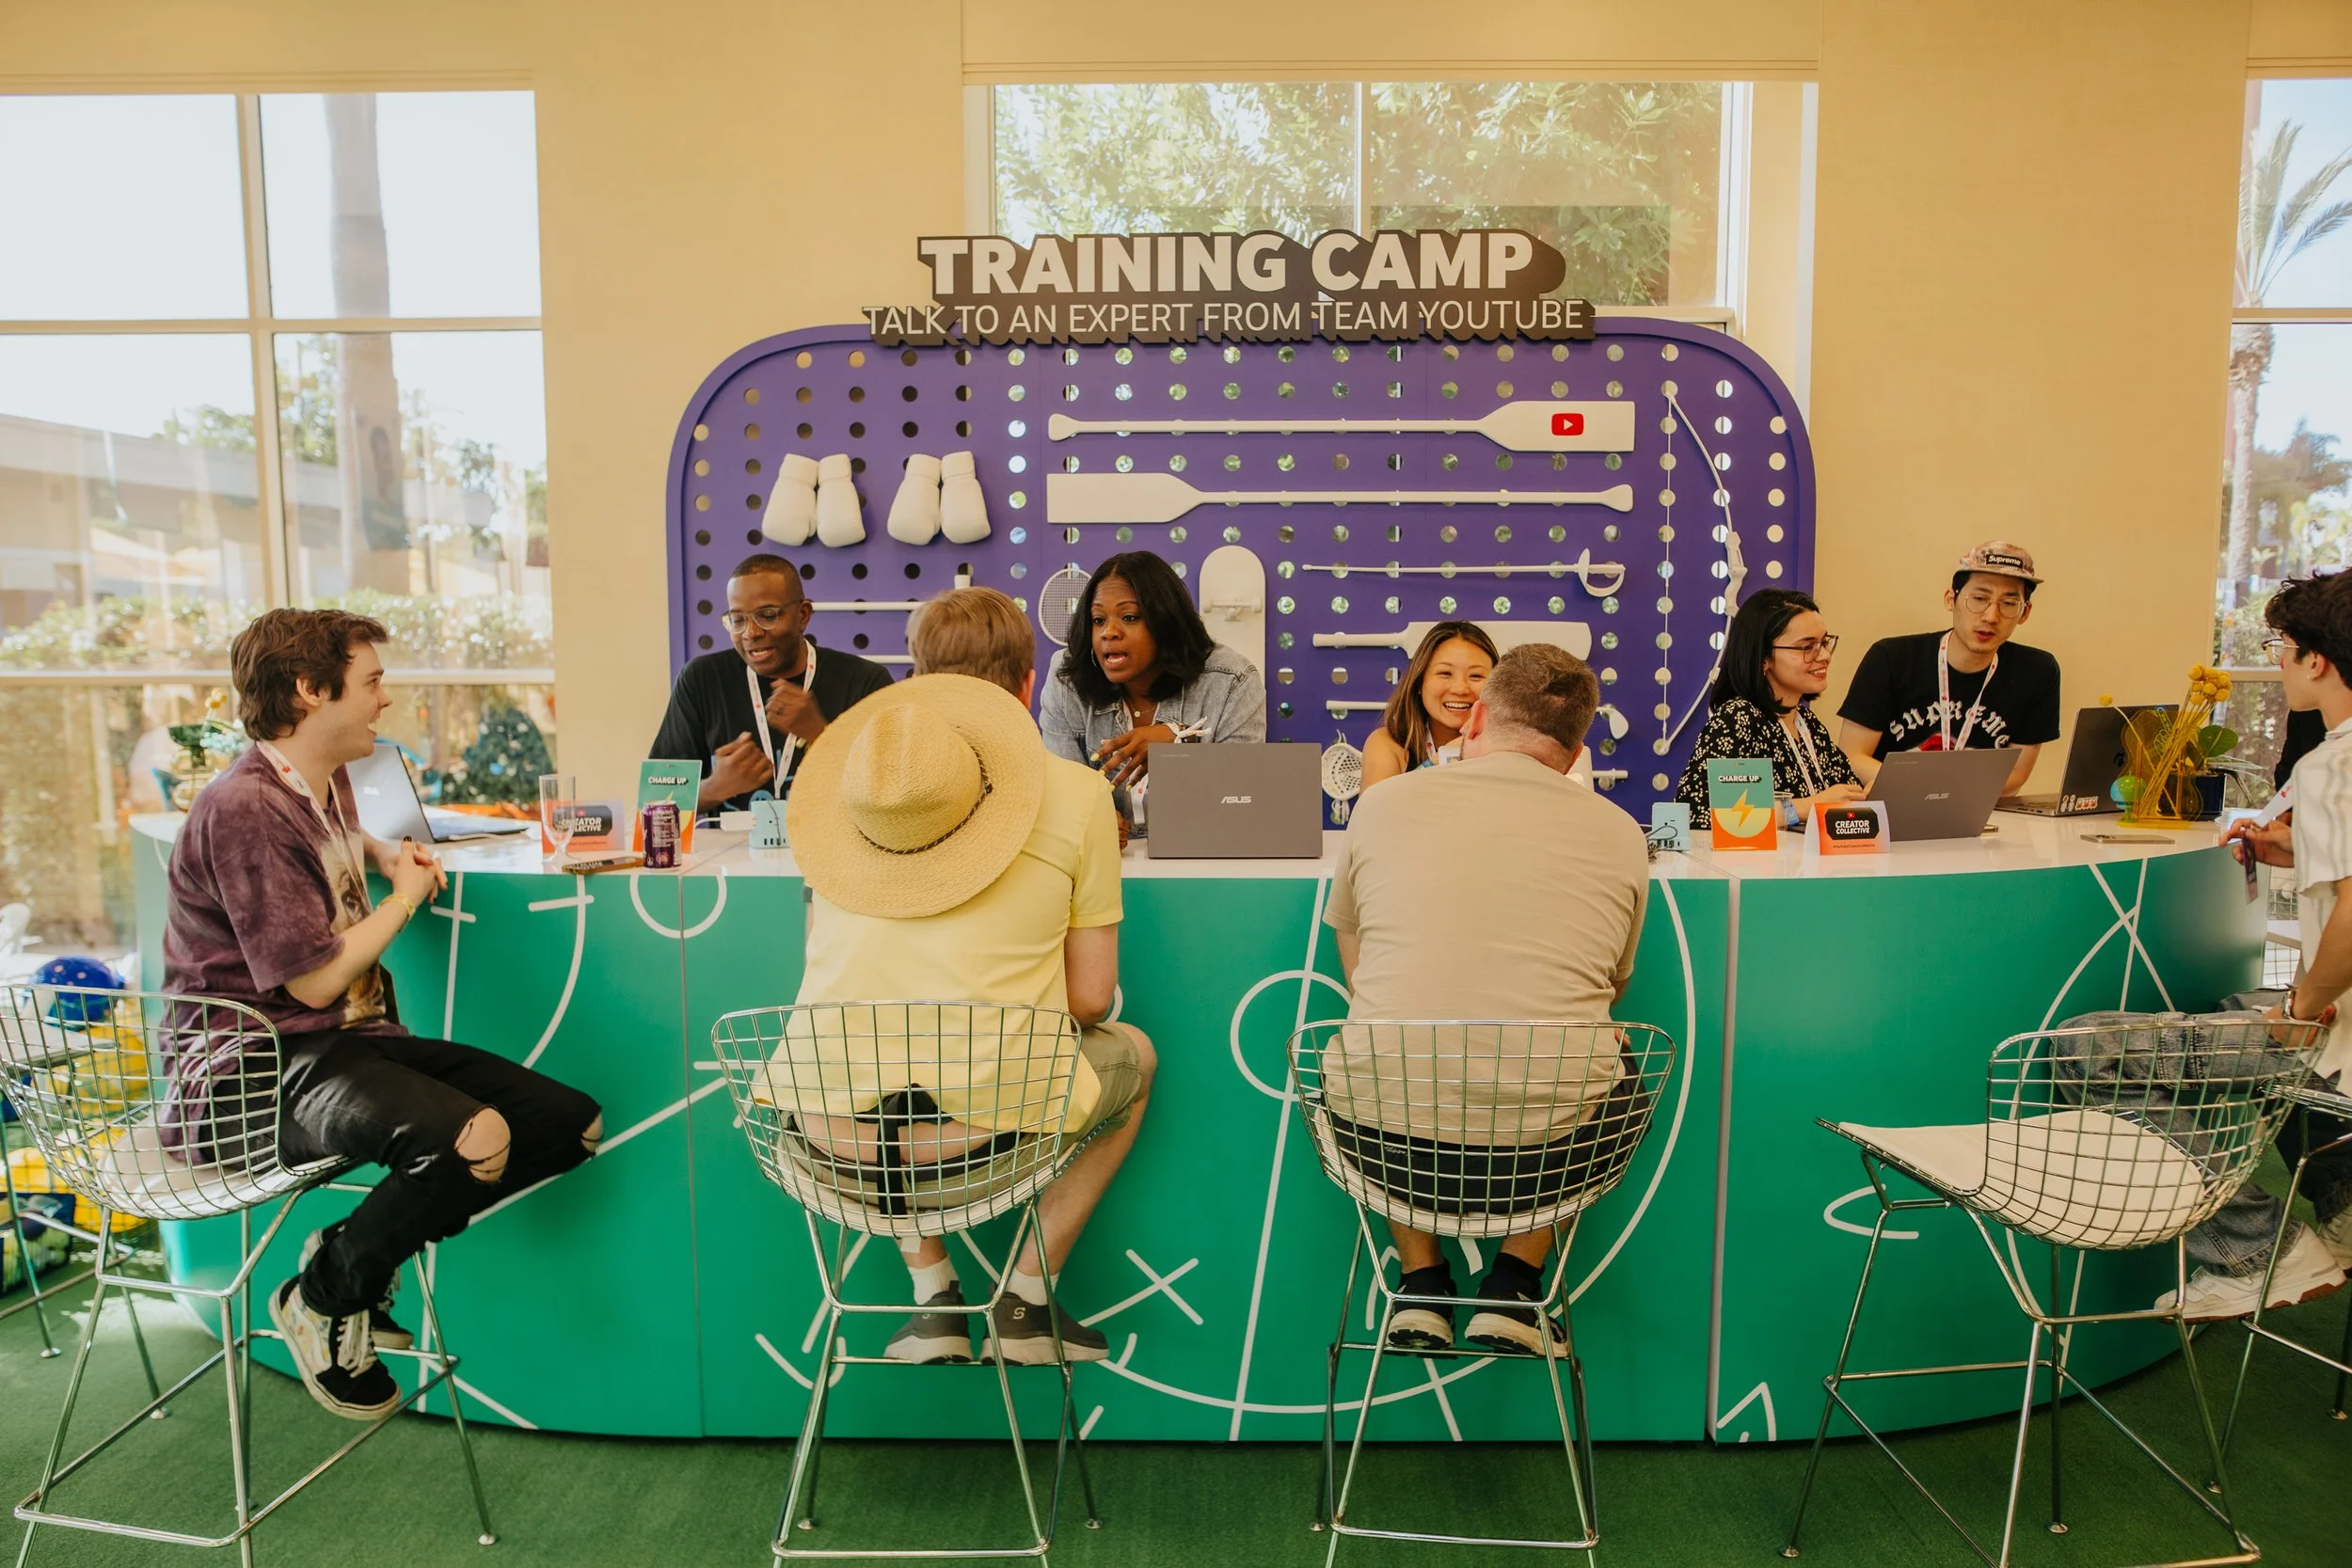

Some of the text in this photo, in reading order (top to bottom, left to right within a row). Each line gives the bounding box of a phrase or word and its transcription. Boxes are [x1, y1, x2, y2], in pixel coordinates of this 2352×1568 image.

[920, 232, 1533, 294] TRAINING CAMP
[863, 299, 1583, 335] TALK TO AN EXPERT FROM TEAM YOUTUBE
[1988, 555, 2021, 565] Supreme
[648, 776, 689, 785] CHARGE UP
[1718, 775, 1761, 784] CHARGE UP
[1220, 796, 1252, 804] ASUS
[1924, 792, 1950, 800] ASUS
[1835, 819, 1870, 829] CREATOR
[1836, 827, 1870, 835] COLLECTIVE
